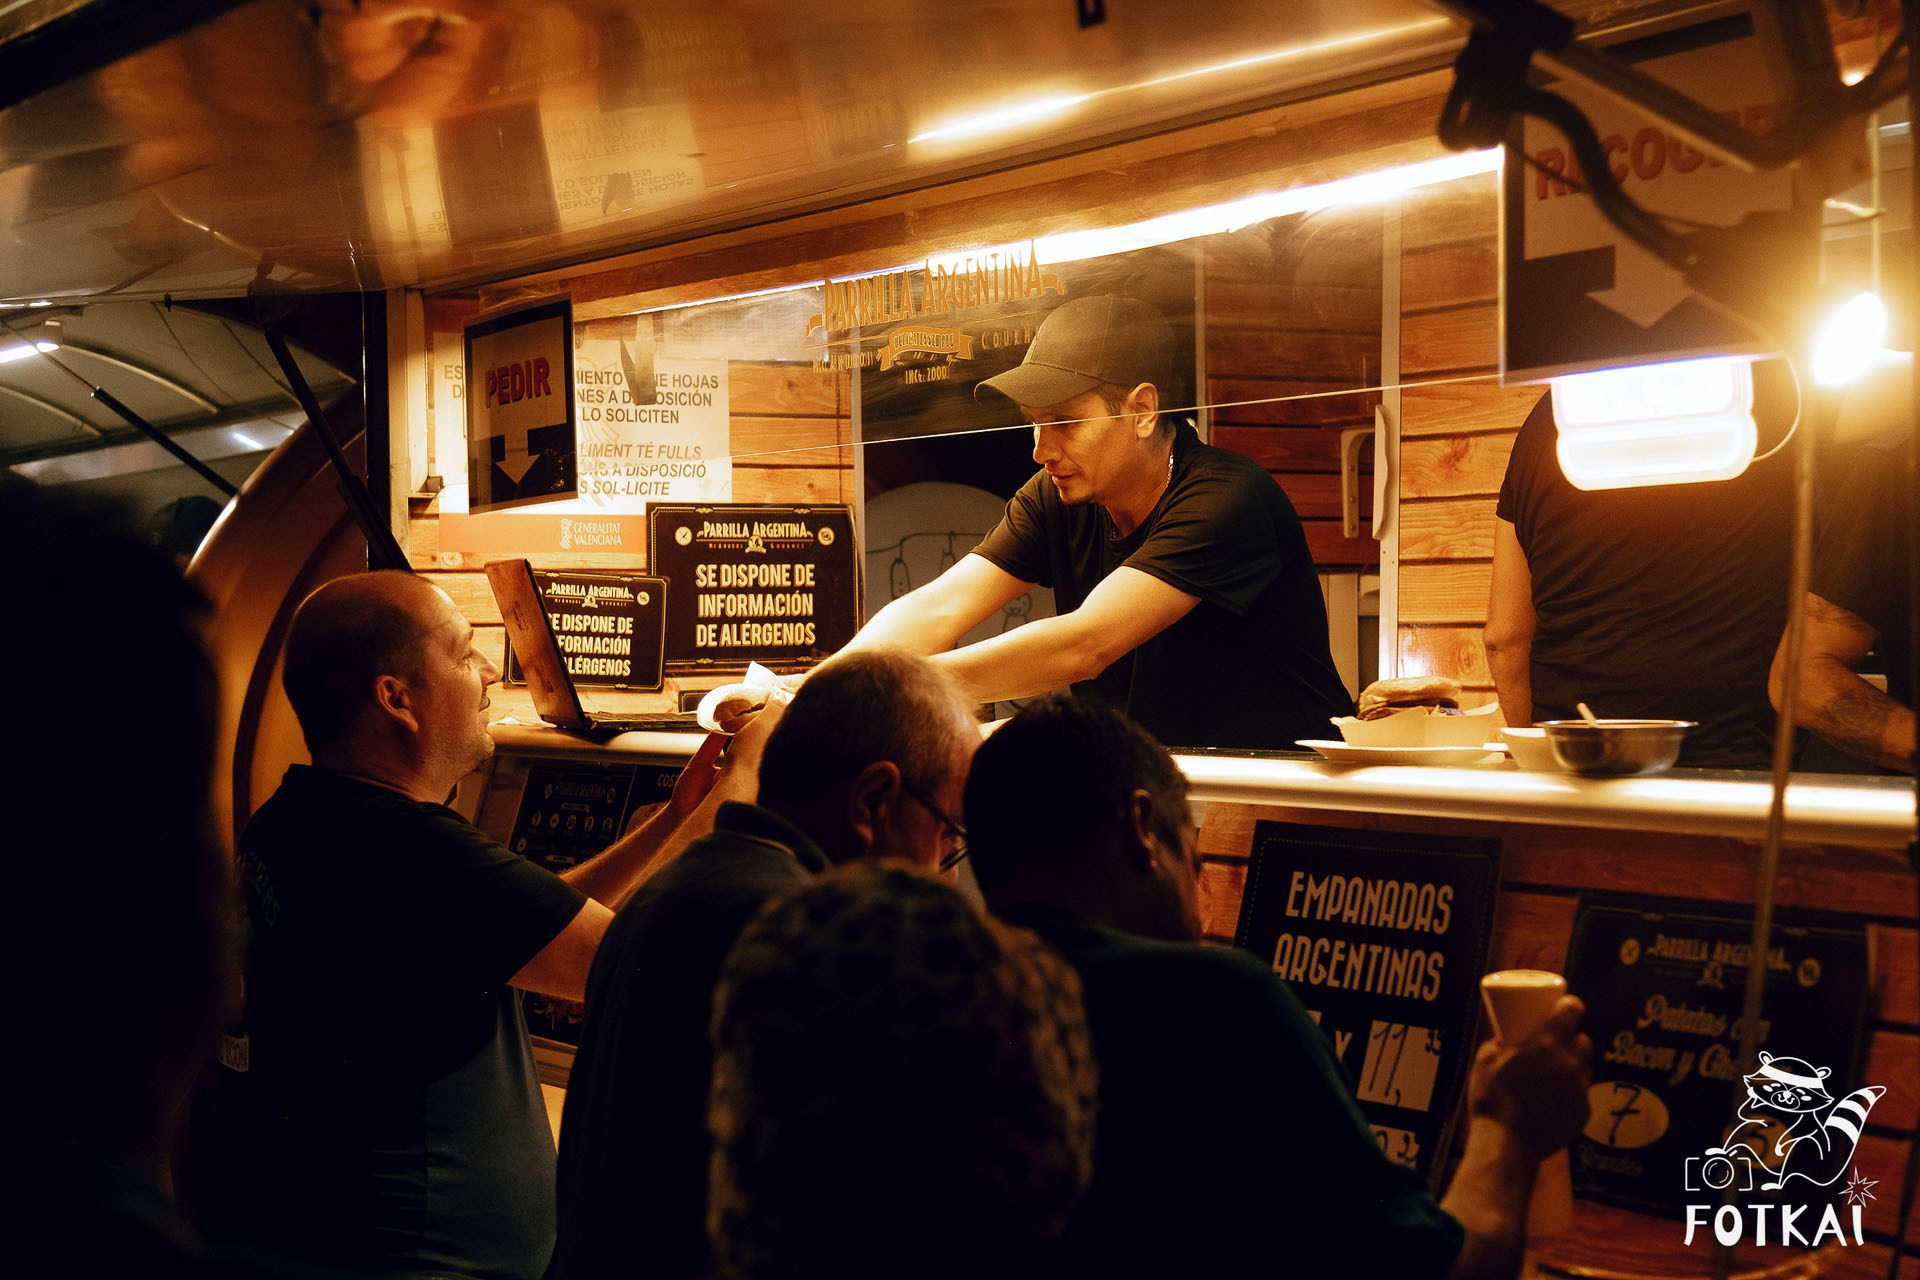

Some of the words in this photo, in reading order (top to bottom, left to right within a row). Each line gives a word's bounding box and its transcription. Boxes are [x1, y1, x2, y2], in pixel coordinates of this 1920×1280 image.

[825, 270, 914, 331] PARRILLA
[921, 238, 1043, 316] ARGENTINA
[485, 357, 552, 408] PEDIR
[672, 374, 719, 389] HOJAS
[608, 390, 618, 404] A
[582, 408, 601, 421] LO
[606, 408, 680, 424] SOLICITEN
[637, 441, 654, 458] TÉ
[657, 445, 702, 460] FULLS
[626, 461, 706, 478] DISPOSICIÓ
[580, 480, 588, 494] S
[573, 522, 622, 534] GENERALITAT
[703, 521, 749, 538] PARRILLA
[753, 521, 807, 538] ARGENTINA
[573, 534, 623, 545] VALENCIANA
[696, 564, 718, 588] SE
[720, 564, 791, 588] DISPONE
[793, 564, 815, 588] DE
[551, 582, 586, 597] PARRILLA
[588, 584, 629, 599] ARGENTINA
[698, 590, 813, 618] INFORMACIÓN
[548, 613, 560, 631] E
[562, 614, 615, 634] DISPONE
[617, 617, 633, 634] DE
[696, 624, 718, 647] DE
[719, 620, 816, 647] ALÉRGENOS
[564, 655, 631, 676] LÉRGENOS
[1285, 871, 1454, 935] EMPANADAS
[1272, 932, 1445, 1002] ARGENTINAS
